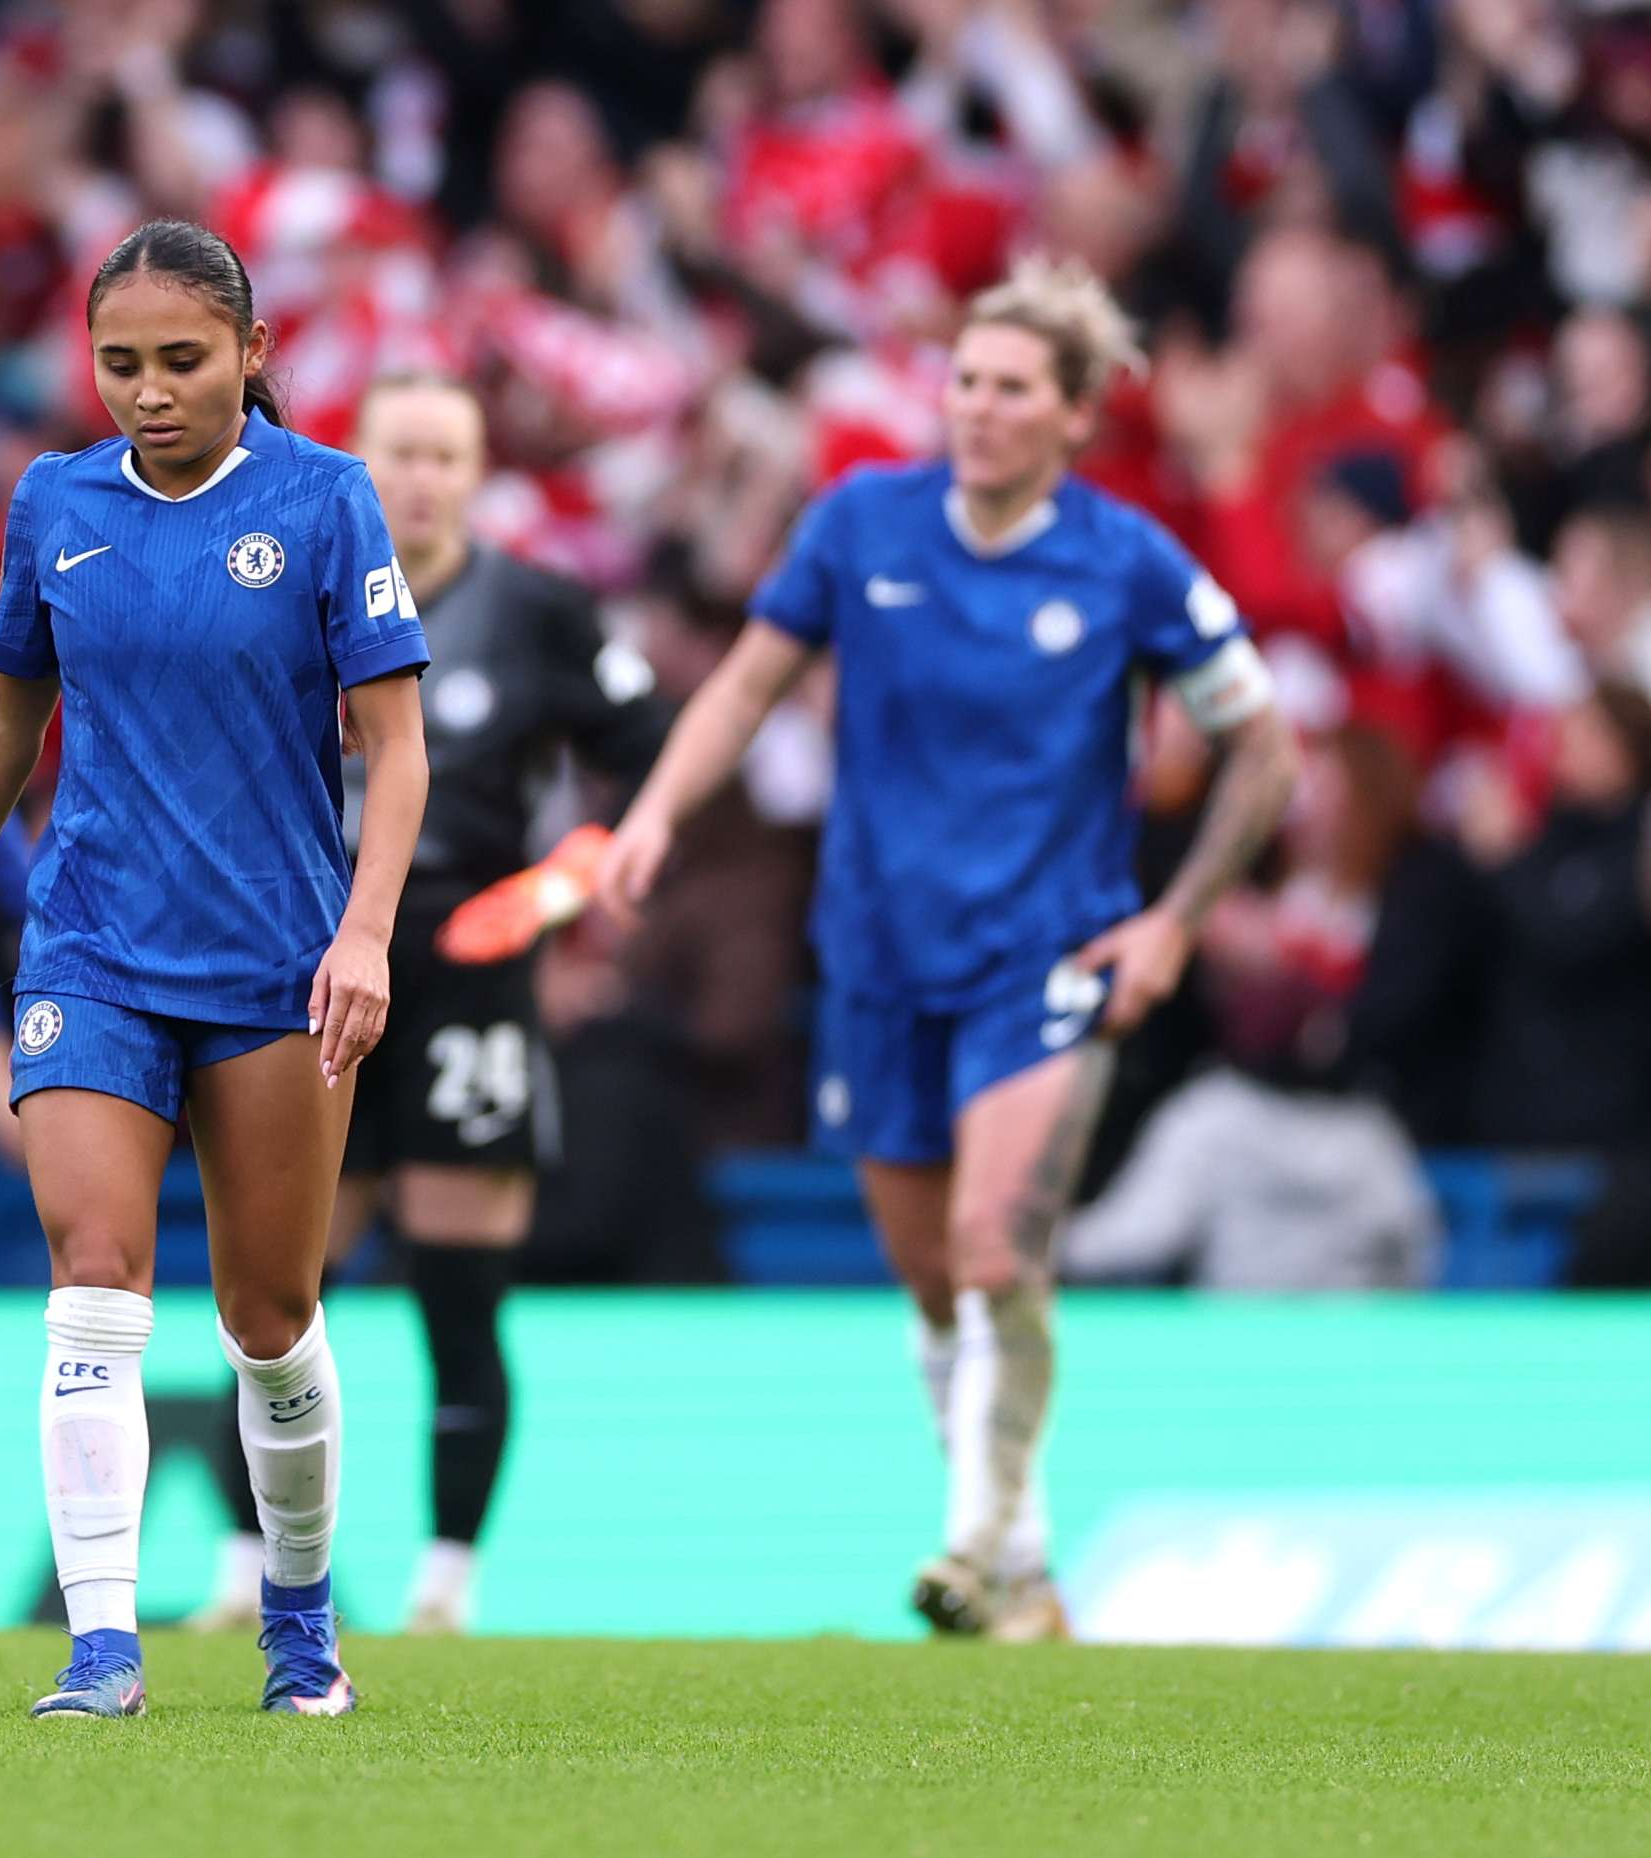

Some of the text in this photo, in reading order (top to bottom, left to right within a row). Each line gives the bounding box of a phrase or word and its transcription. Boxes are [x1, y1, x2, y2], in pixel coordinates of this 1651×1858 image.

[426, 1022, 526, 1121] 24
[59, 1362, 109, 1380] CFC
[269, 1386, 321, 1411] CFC
